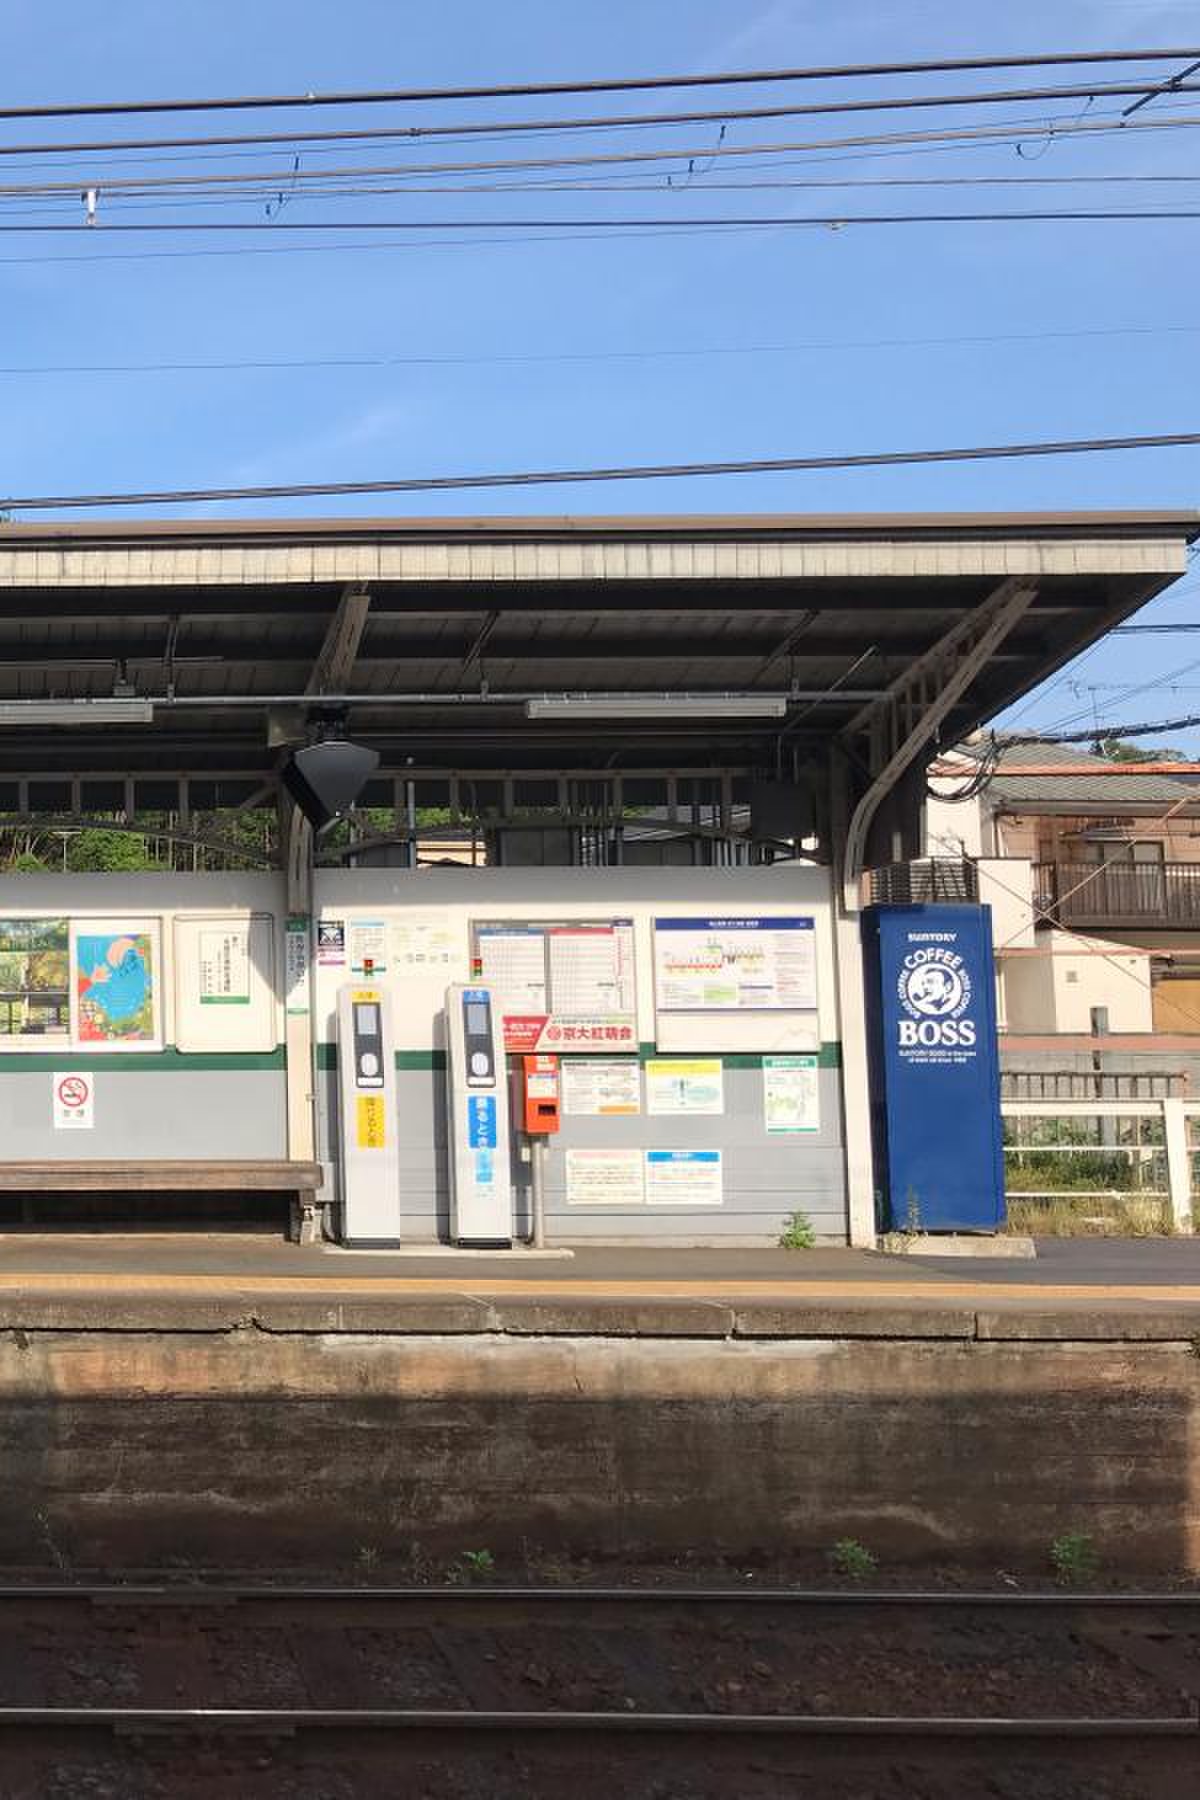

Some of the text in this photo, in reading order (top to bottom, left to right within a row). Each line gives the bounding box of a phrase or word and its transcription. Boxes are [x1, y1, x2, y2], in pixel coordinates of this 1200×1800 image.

[908, 933, 957, 942] SUNTORY
[904, 947, 963, 969] COFFEE
[898, 1020, 976, 1046] BOSS
